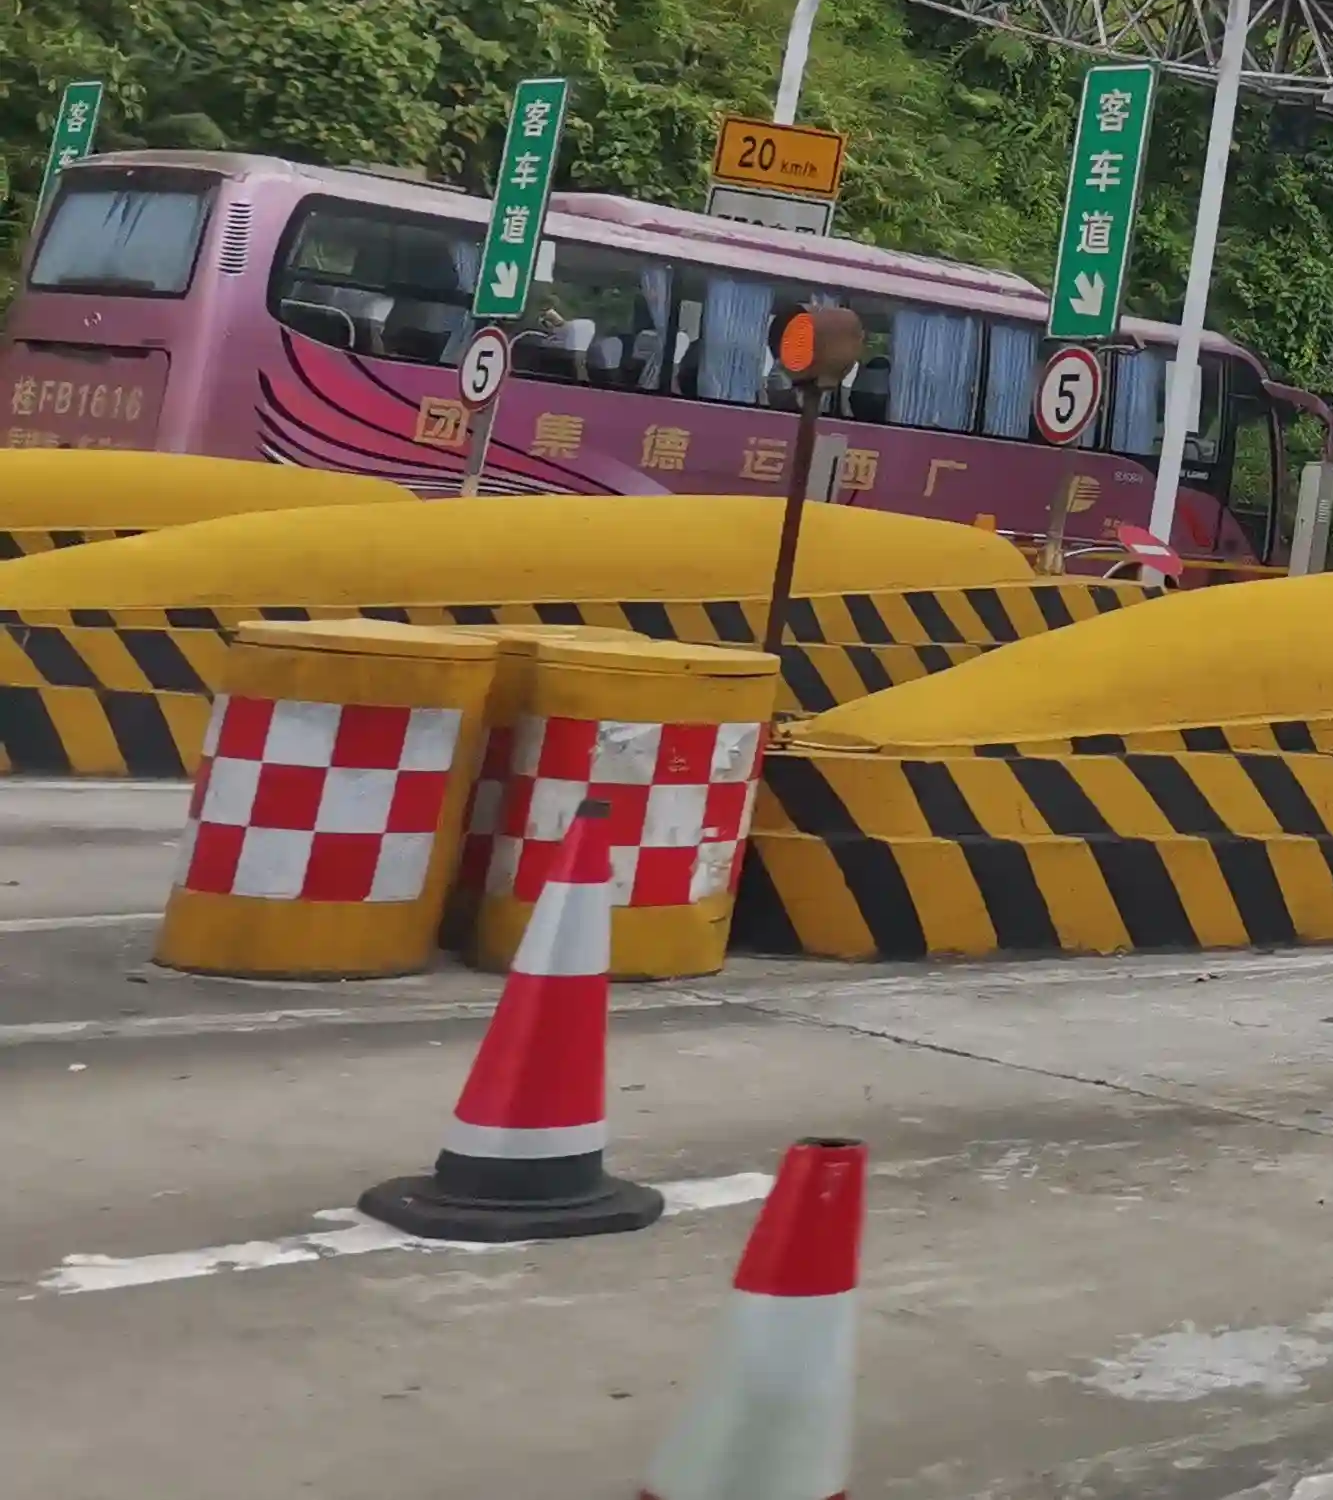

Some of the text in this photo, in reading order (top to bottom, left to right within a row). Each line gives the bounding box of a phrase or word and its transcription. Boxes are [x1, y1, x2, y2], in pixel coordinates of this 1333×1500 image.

[500, 99, 551, 244] 客车道
[738, 136, 777, 171] 20
[1076, 88, 1133, 255] 客车道
[470, 350, 494, 394] 5
[1054, 373, 1082, 423] 5
